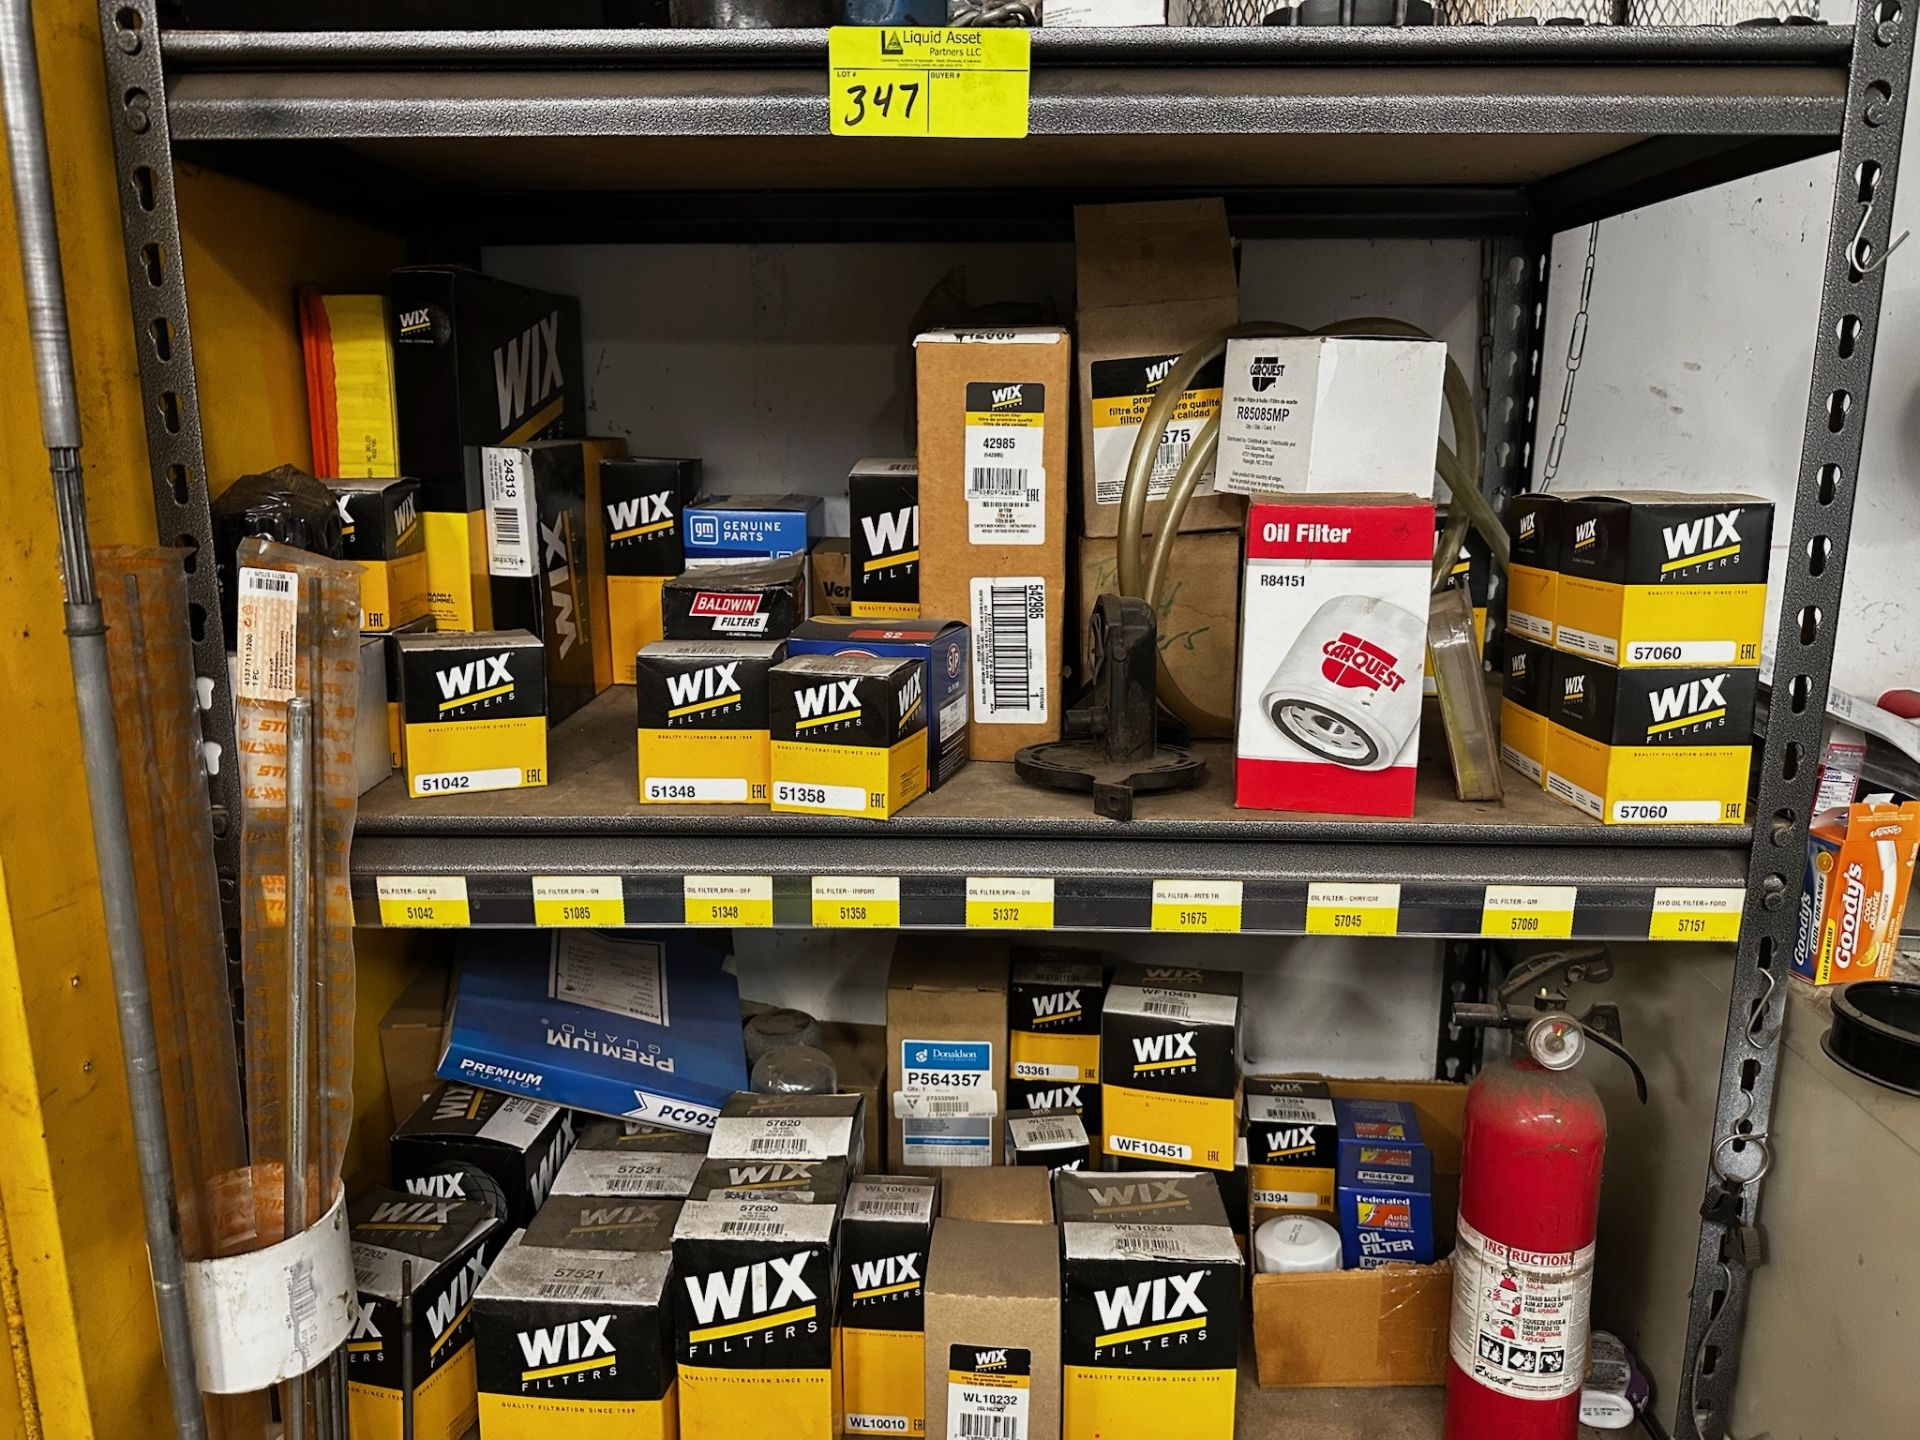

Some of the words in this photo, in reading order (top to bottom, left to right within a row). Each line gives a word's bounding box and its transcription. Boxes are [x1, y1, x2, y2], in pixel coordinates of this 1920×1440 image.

[903, 30, 941, 46] Liquid
[946, 31, 982, 44] Asset
[929, 47, 964, 56] Partners
[966, 48, 982, 56] LLC
[836, 70, 850, 78] LOT
[844, 82, 919, 126] 347
[400, 308, 430, 327] WIX
[493, 309, 564, 431] WIX
[1250, 364, 1286, 377] CARQUEST
[992, 384, 1022, 404] WIX
[1109, 407, 1131, 416] filtre
[1133, 405, 1145, 414] de
[1119, 415, 1142, 425] filtro
[1177, 408, 1210, 419] calidad
[1236, 406, 1290, 422] R85085MP
[983, 437, 1016, 449] 42985
[503, 458, 517, 498] 24313
[394, 491, 417, 536] WIX
[607, 490, 674, 531] WIX
[694, 522, 714, 539] gm
[723, 520, 782, 532] GENUINE
[1519, 511, 1536, 534] WIX
[1575, 518, 1598, 542] WIX
[610, 528, 676, 550] FILTERS
[723, 532, 765, 542] PARTS
[1263, 523, 1290, 542] Oil
[1296, 523, 1352, 544] Filter
[1662, 508, 1742, 560] WIX
[1659, 554, 1741, 582] FILTERS
[540, 510, 577, 661] WIX
[1260, 573, 1306, 588] R84151
[696, 596, 757, 612] BALDWIN
[1028, 584, 1044, 619] 542985
[720, 616, 761, 628] FILTERS
[882, 631, 904, 640] S2
[1511, 653, 1526, 672] WIX
[1633, 646, 1682, 660] 57060
[1322, 639, 1406, 692] CARQUEST
[436, 652, 514, 700] WIX
[666, 660, 742, 706] WIX
[1565, 674, 1585, 694] WIX
[794, 678, 862, 718] WIX
[898, 666, 922, 716] WIX
[1649, 672, 1727, 722] WIX
[439, 692, 515, 720] FILTERS
[668, 702, 742, 727] FILTERS
[258, 719, 287, 733] STI
[796, 718, 862, 738] FILTERS
[1646, 718, 1725, 744] FILTERS
[422, 776, 470, 791] 51042
[651, 784, 696, 798] 51348
[779, 786, 826, 803] 51358
[1620, 805, 1668, 818] 57060
[1815, 874, 1826, 922] ORANGE
[407, 907, 434, 919] 51042
[563, 907, 591, 919] 51085
[711, 906, 739, 919] 51348
[840, 907, 867, 920] 51358
[993, 908, 1019, 921] 51372
[1180, 911, 1208, 925] 51675
[1834, 862, 1866, 969] Goody's
[1863, 896, 1872, 923] COOL
[1869, 890, 1881, 930] ORANGE
[1334, 914, 1362, 928] 57045
[1511, 917, 1539, 931] 57060
[1677, 919, 1706, 932] 57151
[1794, 891, 1812, 967] Goody's
[1142, 987, 1198, 999] WF10451
[1032, 989, 1082, 1017] WIX
[561, 1022, 661, 1055] GUARD
[1132, 1031, 1197, 1063] WIX
[547, 1028, 675, 1074] PREMIUM
[933, 1048, 977, 1058] Donaldson
[459, 1058, 544, 1086] PREMIUM
[466, 1070, 530, 1089] GUARD
[908, 1072, 981, 1087] P564357
[1017, 1064, 1050, 1077] 33361
[1133, 1065, 1197, 1079] FILTERS
[1027, 1085, 1083, 1110] WIX
[766, 1119, 801, 1127] 57620
[1117, 1137, 1184, 1158] WF10451
[1266, 1125, 1316, 1151] WIX
[530, 1110, 576, 1212] WIX
[617, 1165, 662, 1174] 57521
[729, 1164, 813, 1186] WIX
[405, 1172, 467, 1199] WIX
[864, 1184, 920, 1193] WL10010
[1088, 1179, 1190, 1207] WIX
[1254, 1192, 1289, 1203] 51394
[1356, 1195, 1410, 1205] Federated
[369, 1202, 464, 1224] WIX
[580, 1204, 665, 1226] WIX
[740, 1205, 779, 1213] 57620
[1092, 1204, 1193, 1221] FILTERS
[1387, 1213, 1409, 1221] Auto
[1113, 1224, 1175, 1232] WL10242
[1384, 1220, 1409, 1228] Parts
[1359, 1231, 1385, 1244] OIL
[1362, 1239, 1415, 1256] FILTER
[554, 1267, 605, 1280] 57521
[851, 1252, 921, 1290] WIX
[426, 1243, 489, 1340] WIX
[685, 1251, 818, 1325] WIX
[852, 1288, 921, 1308] FILTERS
[1094, 1270, 1208, 1331] WIX
[517, 1314, 617, 1368] WIX
[690, 1320, 818, 1358] FILTERS
[1095, 1330, 1208, 1360] FILTERS
[975, 1349, 1008, 1365] WIX
[522, 1366, 618, 1392] FILTERS
[1117, 1374, 1168, 1382] FILTRATION
[963, 1392, 1018, 1405] WL10232
[538, 1404, 586, 1413] FILTRATION
[850, 1416, 905, 1430] WL10010
